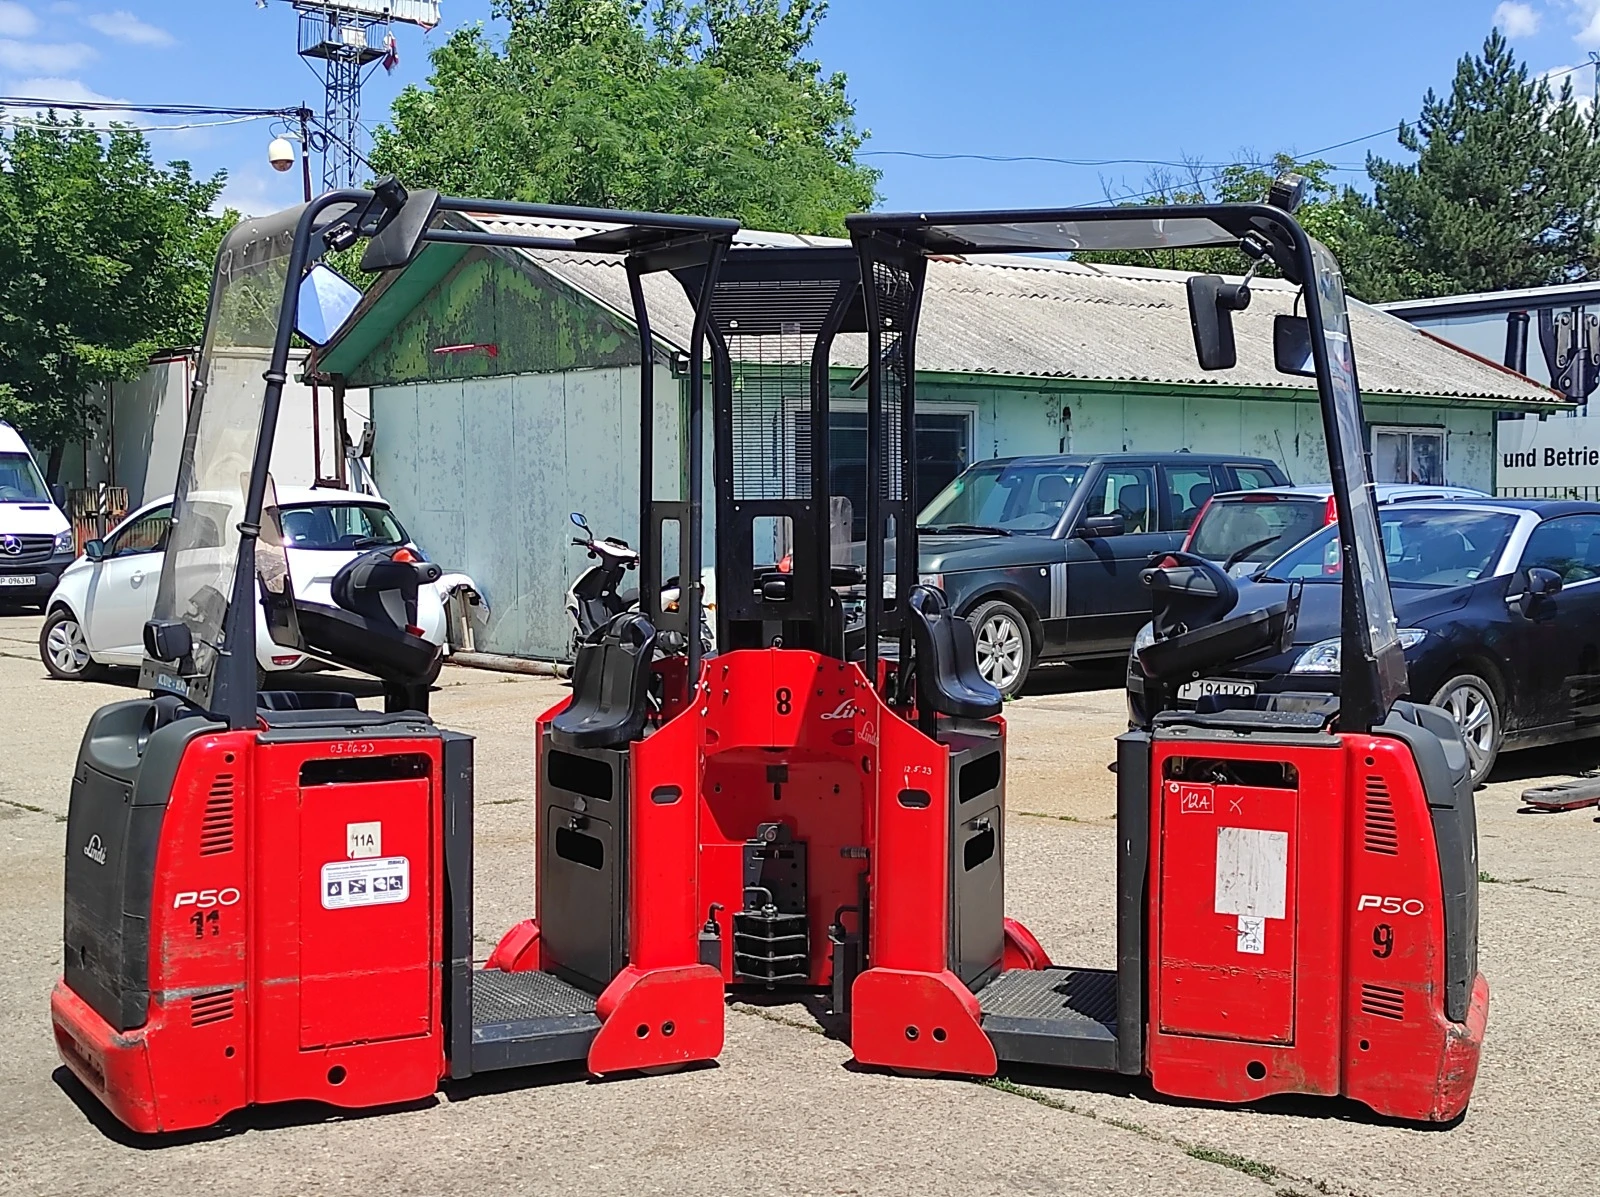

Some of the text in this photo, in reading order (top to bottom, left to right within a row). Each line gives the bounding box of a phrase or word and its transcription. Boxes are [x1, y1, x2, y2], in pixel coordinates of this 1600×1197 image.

[1503, 446, 1599, 468] und Betrie
[776, 687, 792, 715] 8
[84, 834, 106, 865] Linde
[354, 833, 374, 847] 11A
[173, 887, 240, 909] P50
[1357, 894, 1424, 916] P50
[189, 909, 219, 940] 11
[1372, 923, 1394, 959] 9
